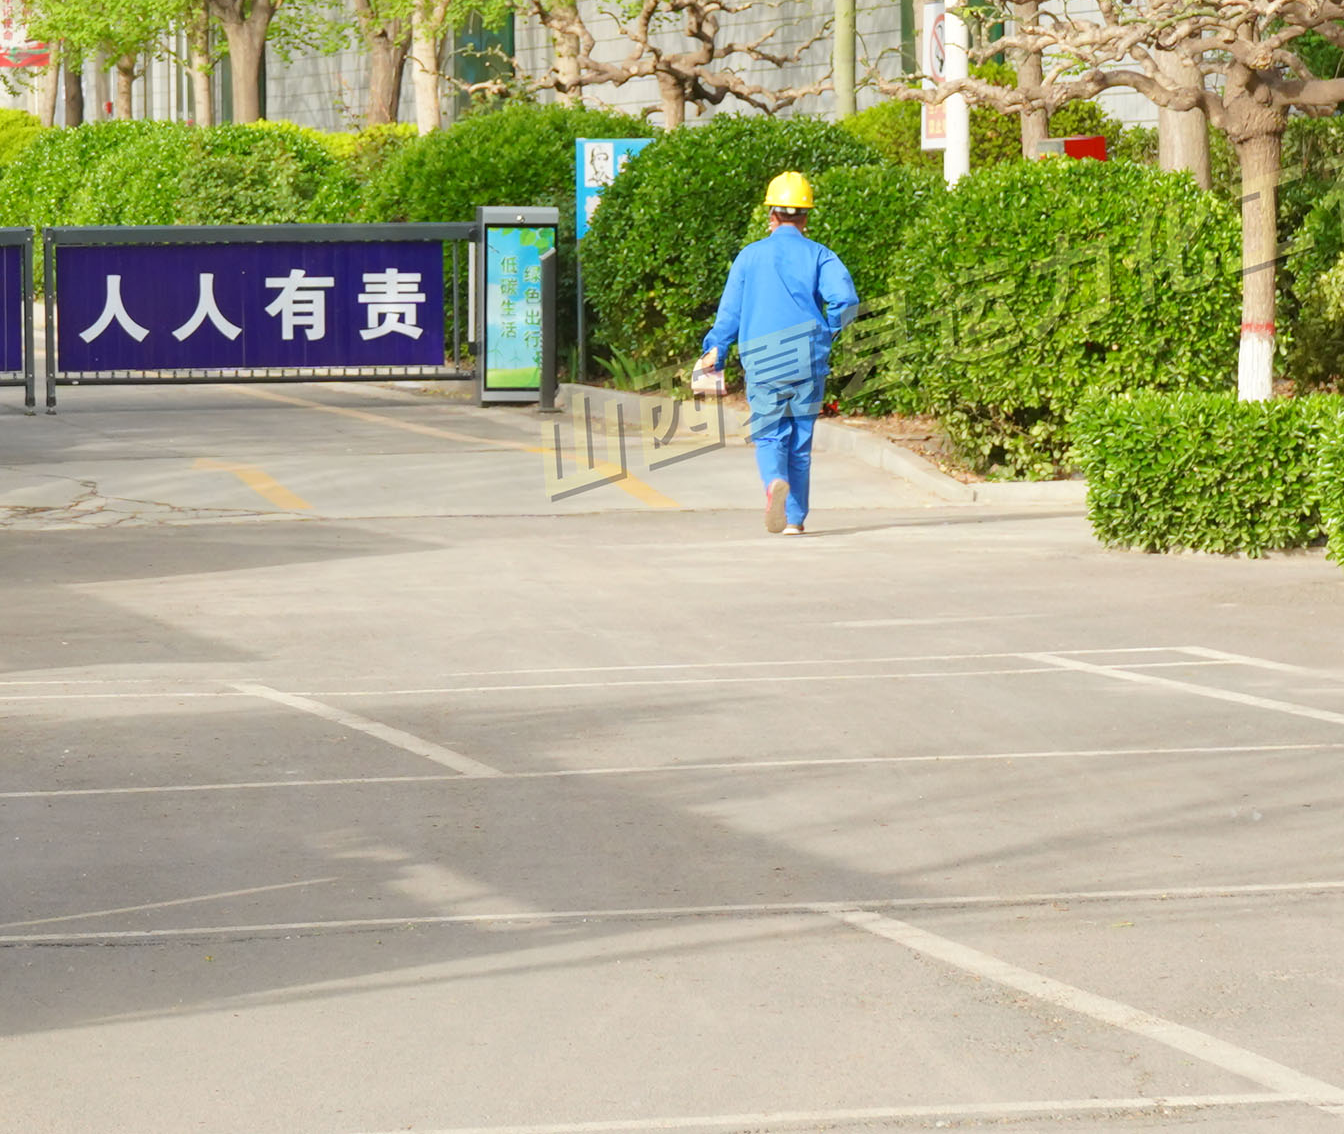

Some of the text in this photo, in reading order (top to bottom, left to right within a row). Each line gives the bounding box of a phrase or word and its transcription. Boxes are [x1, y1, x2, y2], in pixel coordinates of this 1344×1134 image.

[79, 266, 428, 344] 人人有责
[500, 256, 519, 339] 低碳生活
[523, 266, 542, 349] 绿色出行
